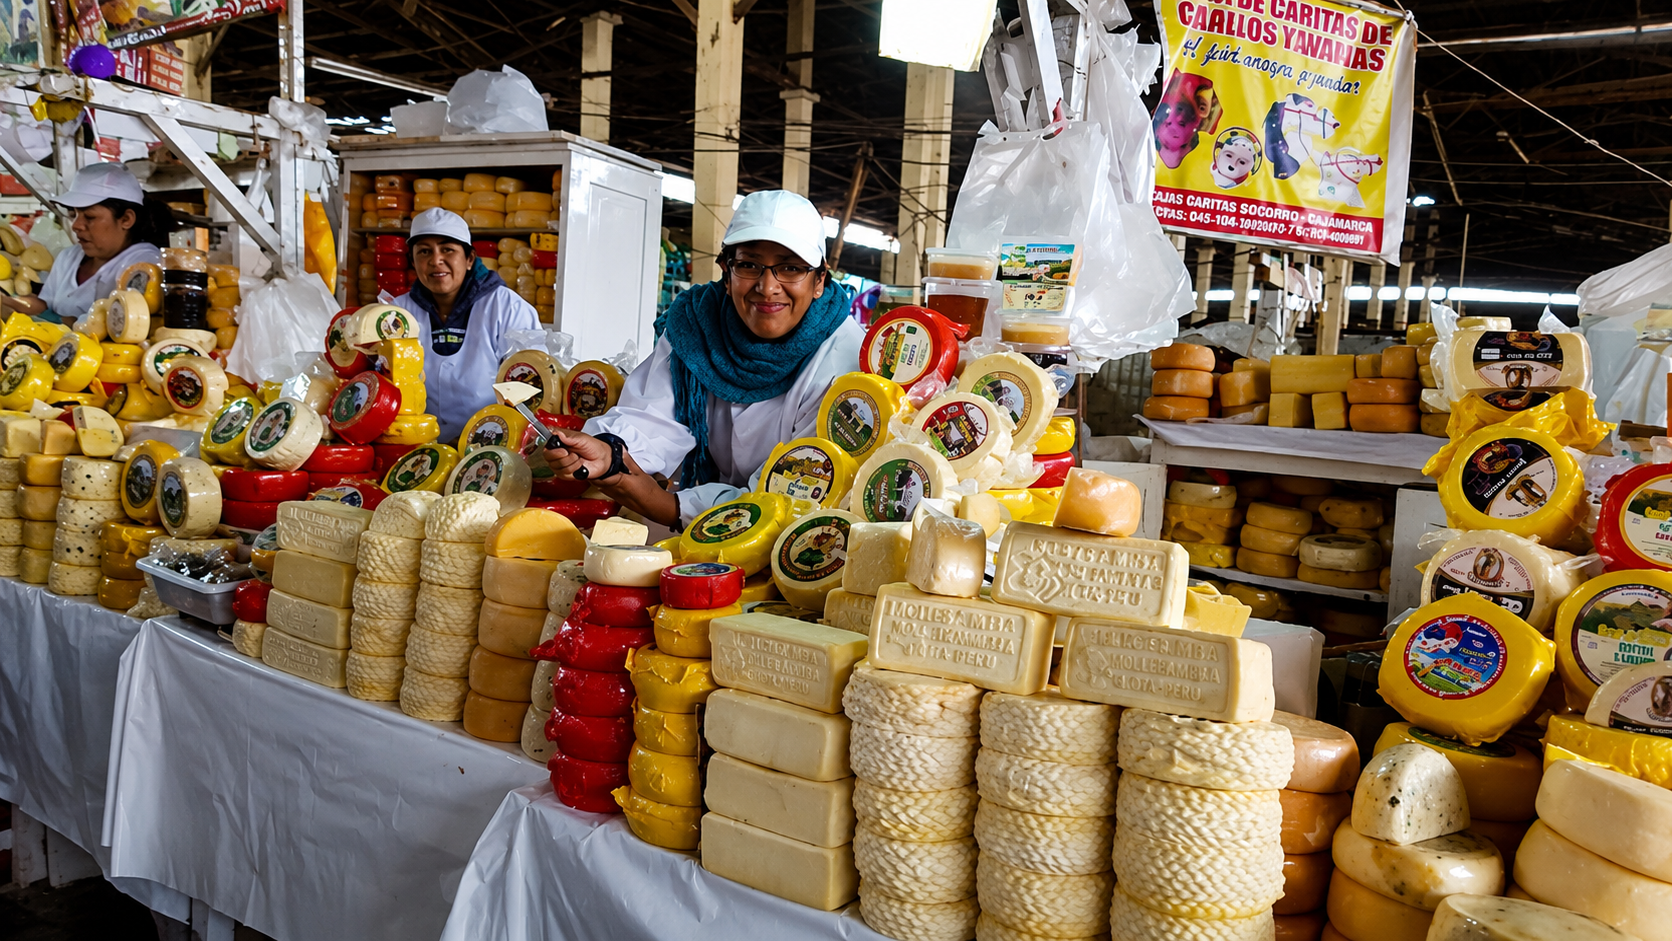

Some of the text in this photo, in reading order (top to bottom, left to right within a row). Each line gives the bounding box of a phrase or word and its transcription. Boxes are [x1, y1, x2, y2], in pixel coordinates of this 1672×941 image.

[1271, 0, 1359, 40] CARITAS
[1361, 21, 1392, 45] DE
[1186, 194, 1237, 213] CARITAS
